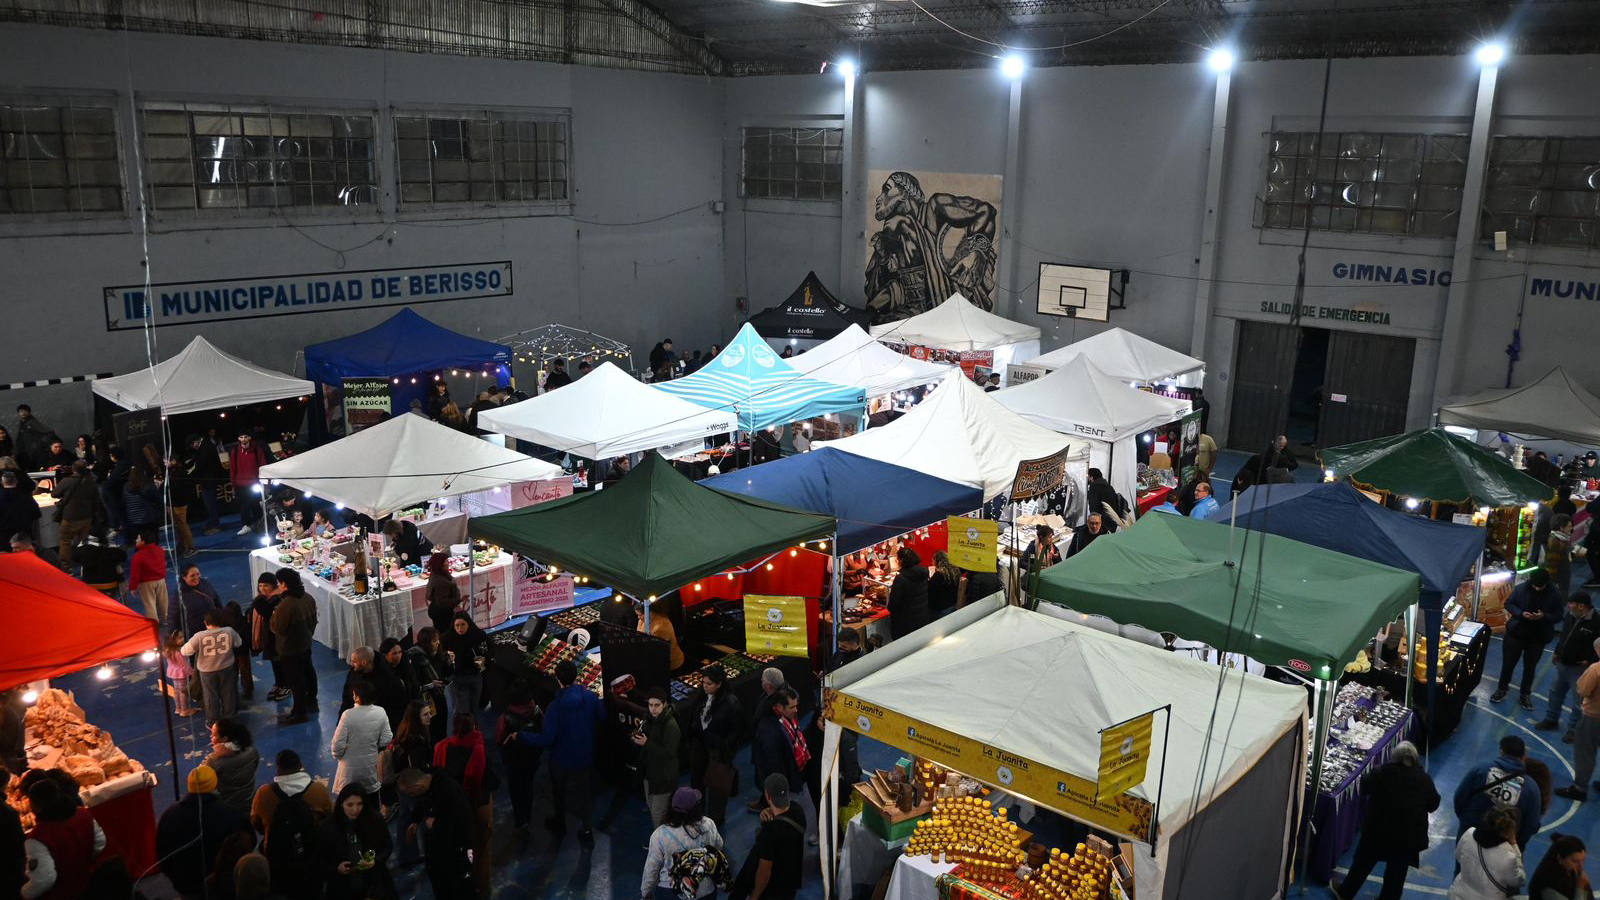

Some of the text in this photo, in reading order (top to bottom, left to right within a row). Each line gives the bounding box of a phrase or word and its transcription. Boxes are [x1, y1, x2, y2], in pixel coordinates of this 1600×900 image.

[1332, 262, 1450, 287] GIMNASIO
[161, 270, 501, 317] MUNICIPALIDAD DE BERISSO
[793, 306, 825, 314] castello
[1301, 305, 1316, 318] DE
[1318, 307, 1391, 325] EMERGENCIA
[359, 398, 388, 406] AZÚCAR
[1073, 423, 1106, 438] TRENT
[519, 598, 554, 608] ARGENTINO
[520, 587, 569, 601] ARTESANAL
[202, 633, 230, 656] 23
[844, 697, 883, 717] La Juanita
[982, 745, 1029, 769] La Juanita
[1490, 786, 1512, 802] 40
